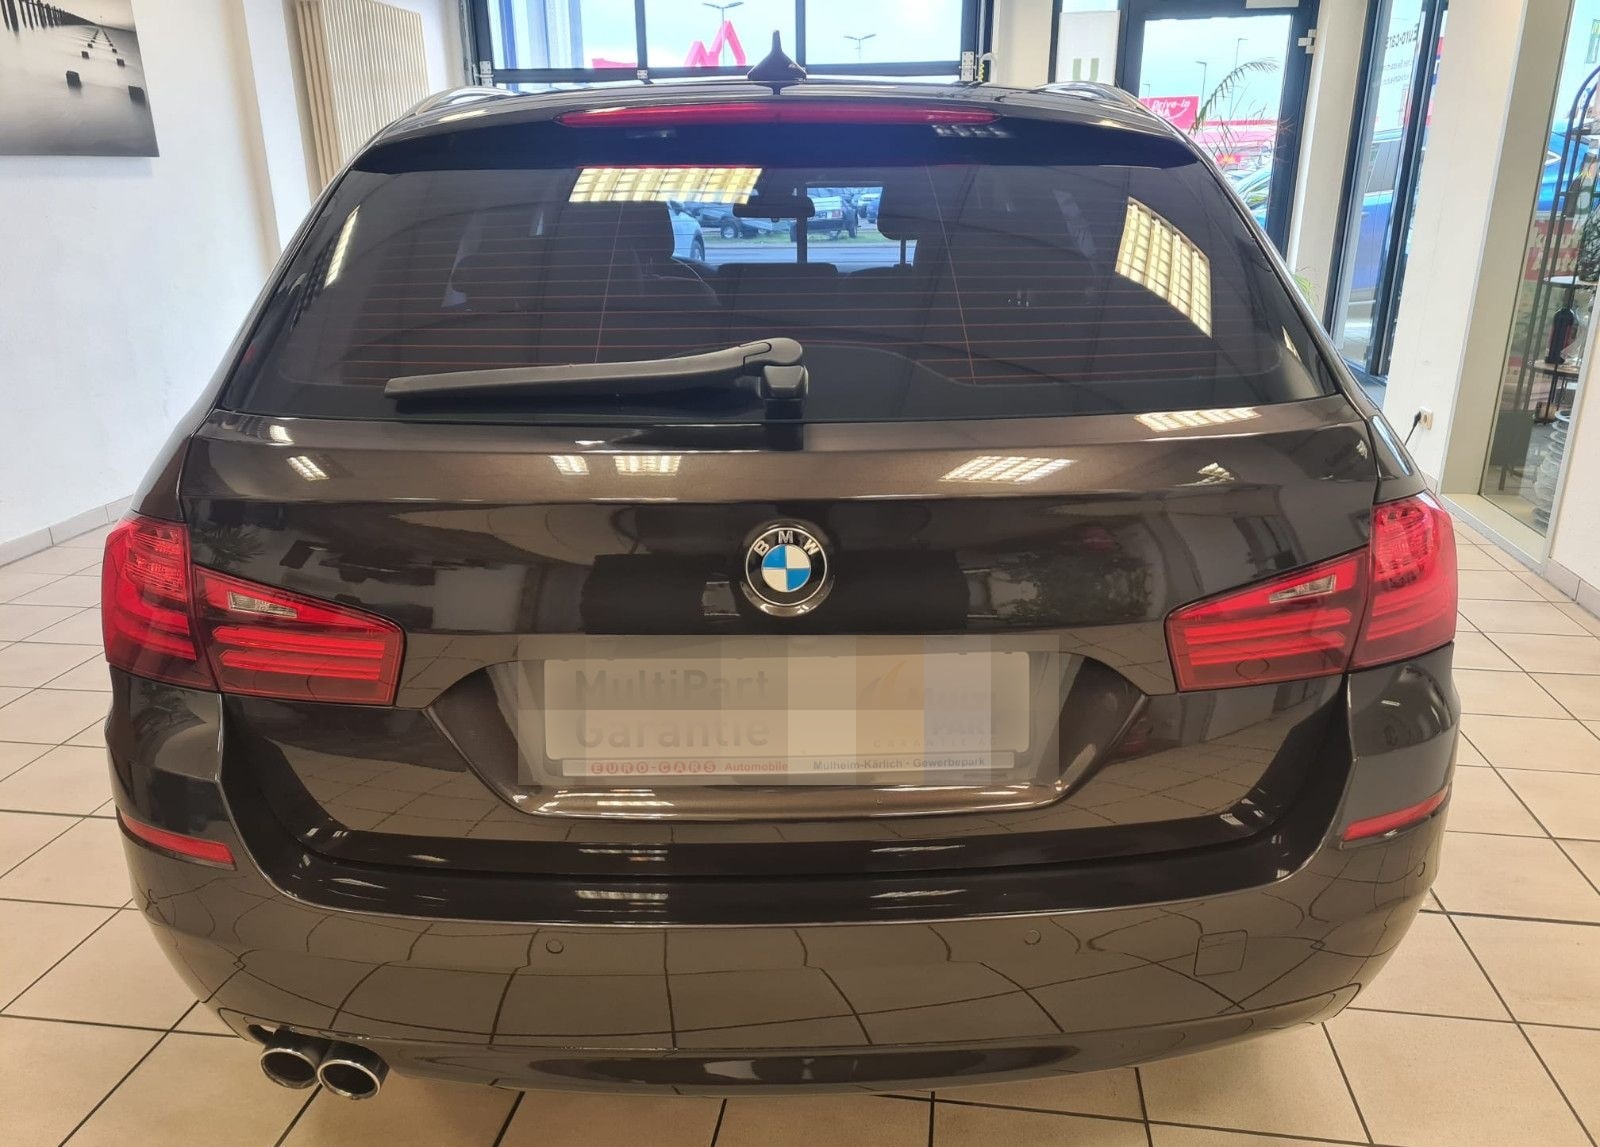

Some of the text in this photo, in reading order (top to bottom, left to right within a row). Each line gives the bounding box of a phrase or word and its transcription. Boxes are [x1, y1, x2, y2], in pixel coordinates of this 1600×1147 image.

[753, 530, 820, 557] BMW
[591, 760, 716, 775] EURO-CARS
[725, 760, 788, 772] Automobile
[912, 757, 986, 769] Gewerbepark
